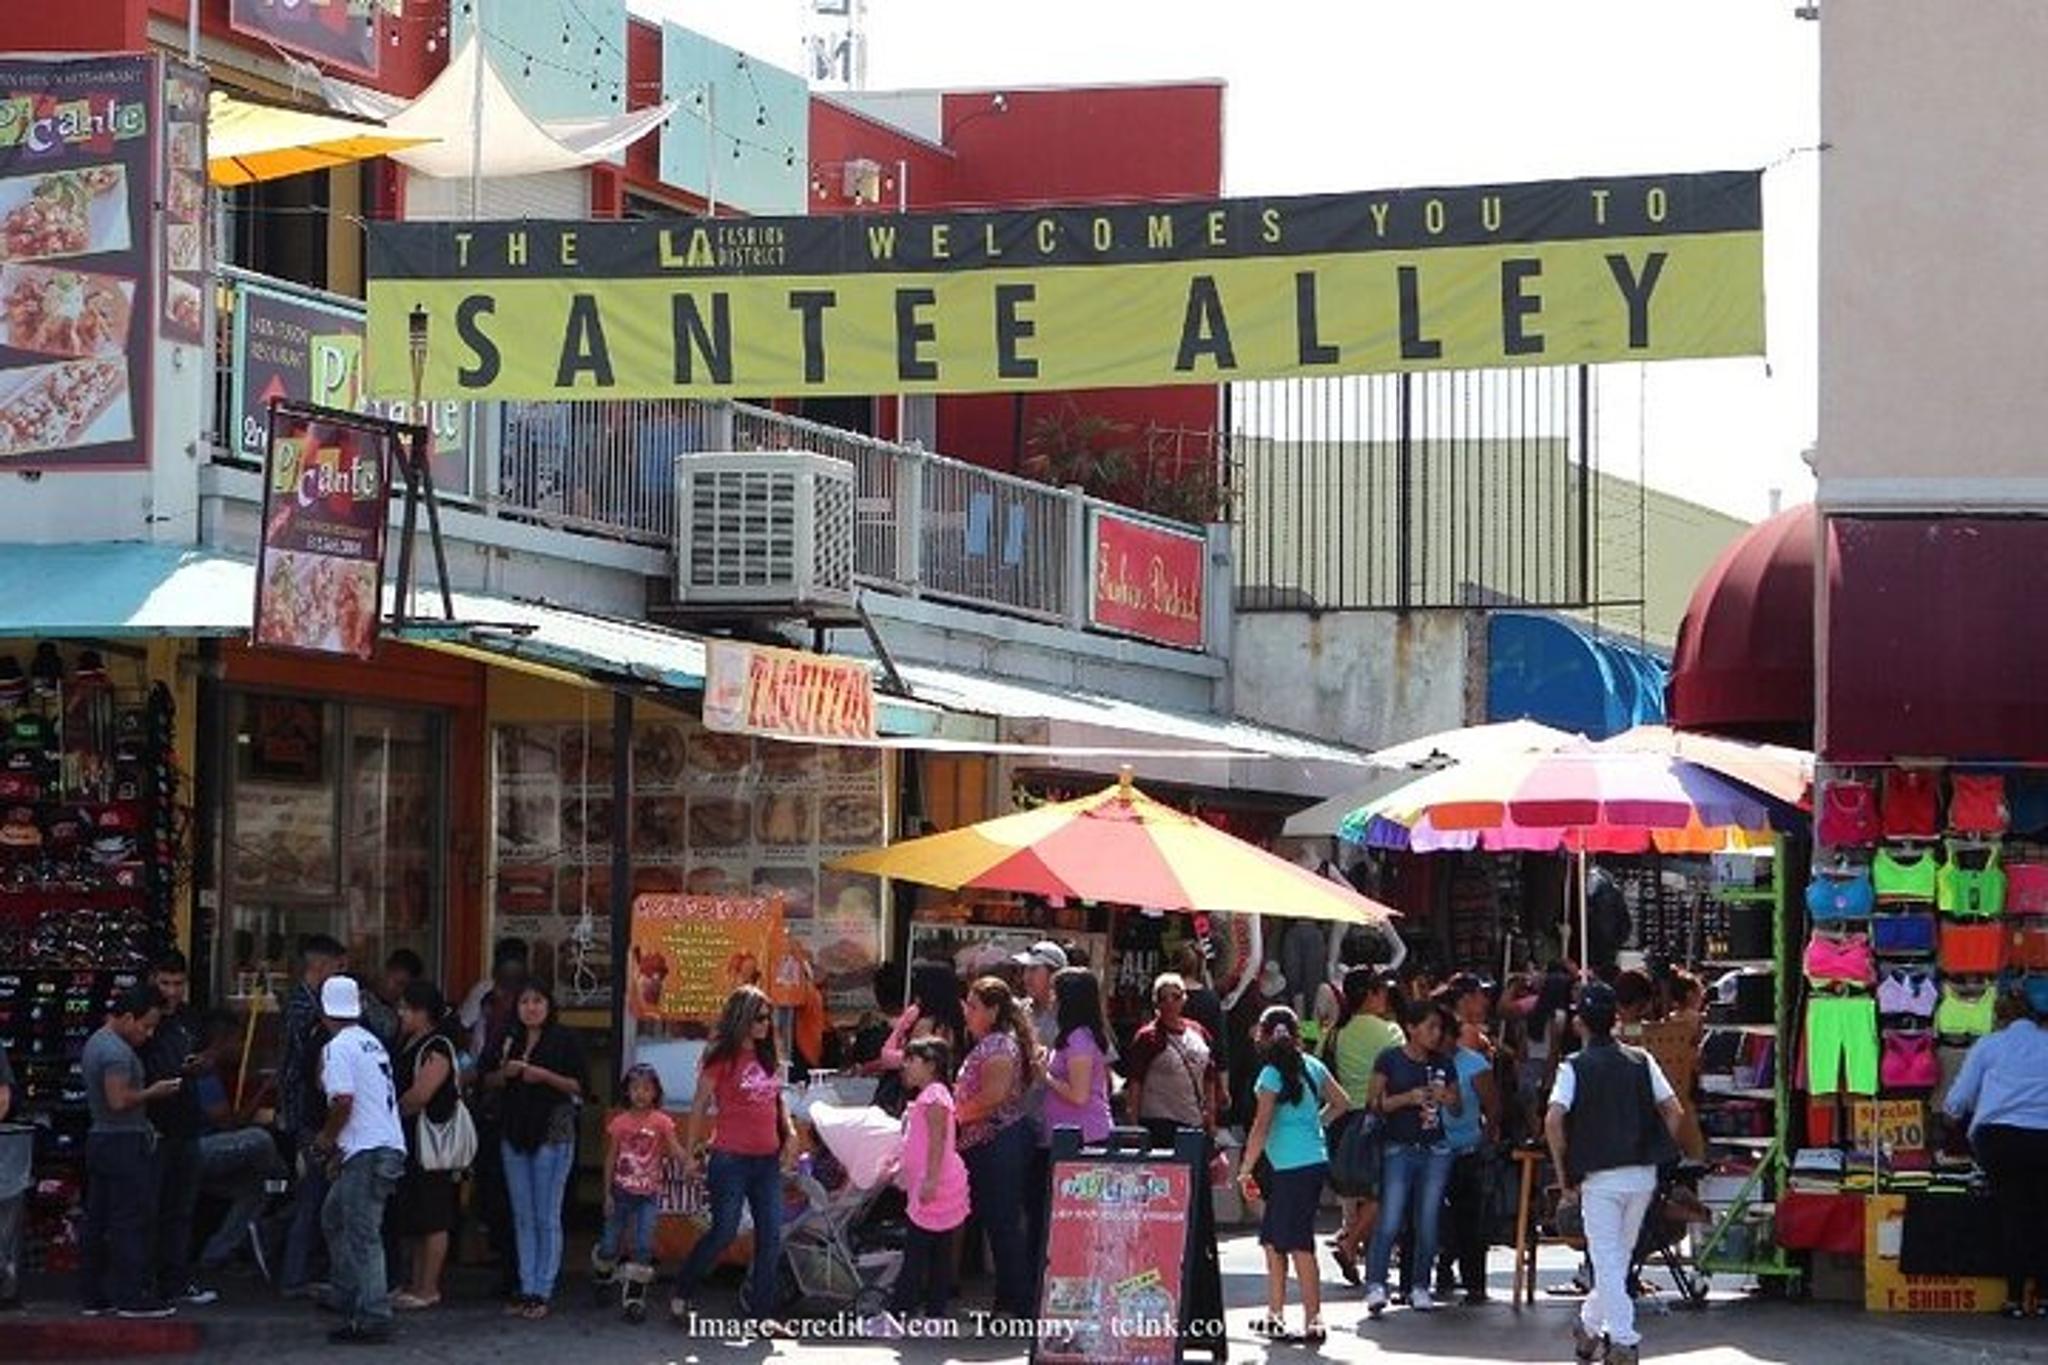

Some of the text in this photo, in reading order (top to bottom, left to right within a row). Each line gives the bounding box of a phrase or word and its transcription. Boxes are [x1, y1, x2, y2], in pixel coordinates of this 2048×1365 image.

[456, 232, 578, 267] THE
[659, 229, 715, 268] LA
[718, 247, 785, 268] DISTRICT
[869, 209, 1281, 260] WELCOMES
[1371, 198, 1501, 236] YOU
[1592, 188, 1668, 223] TO
[456, 252, 1668, 387] SANTEE ALLEY
[1887, 1288, 1976, 1309] T-SHIRTS
